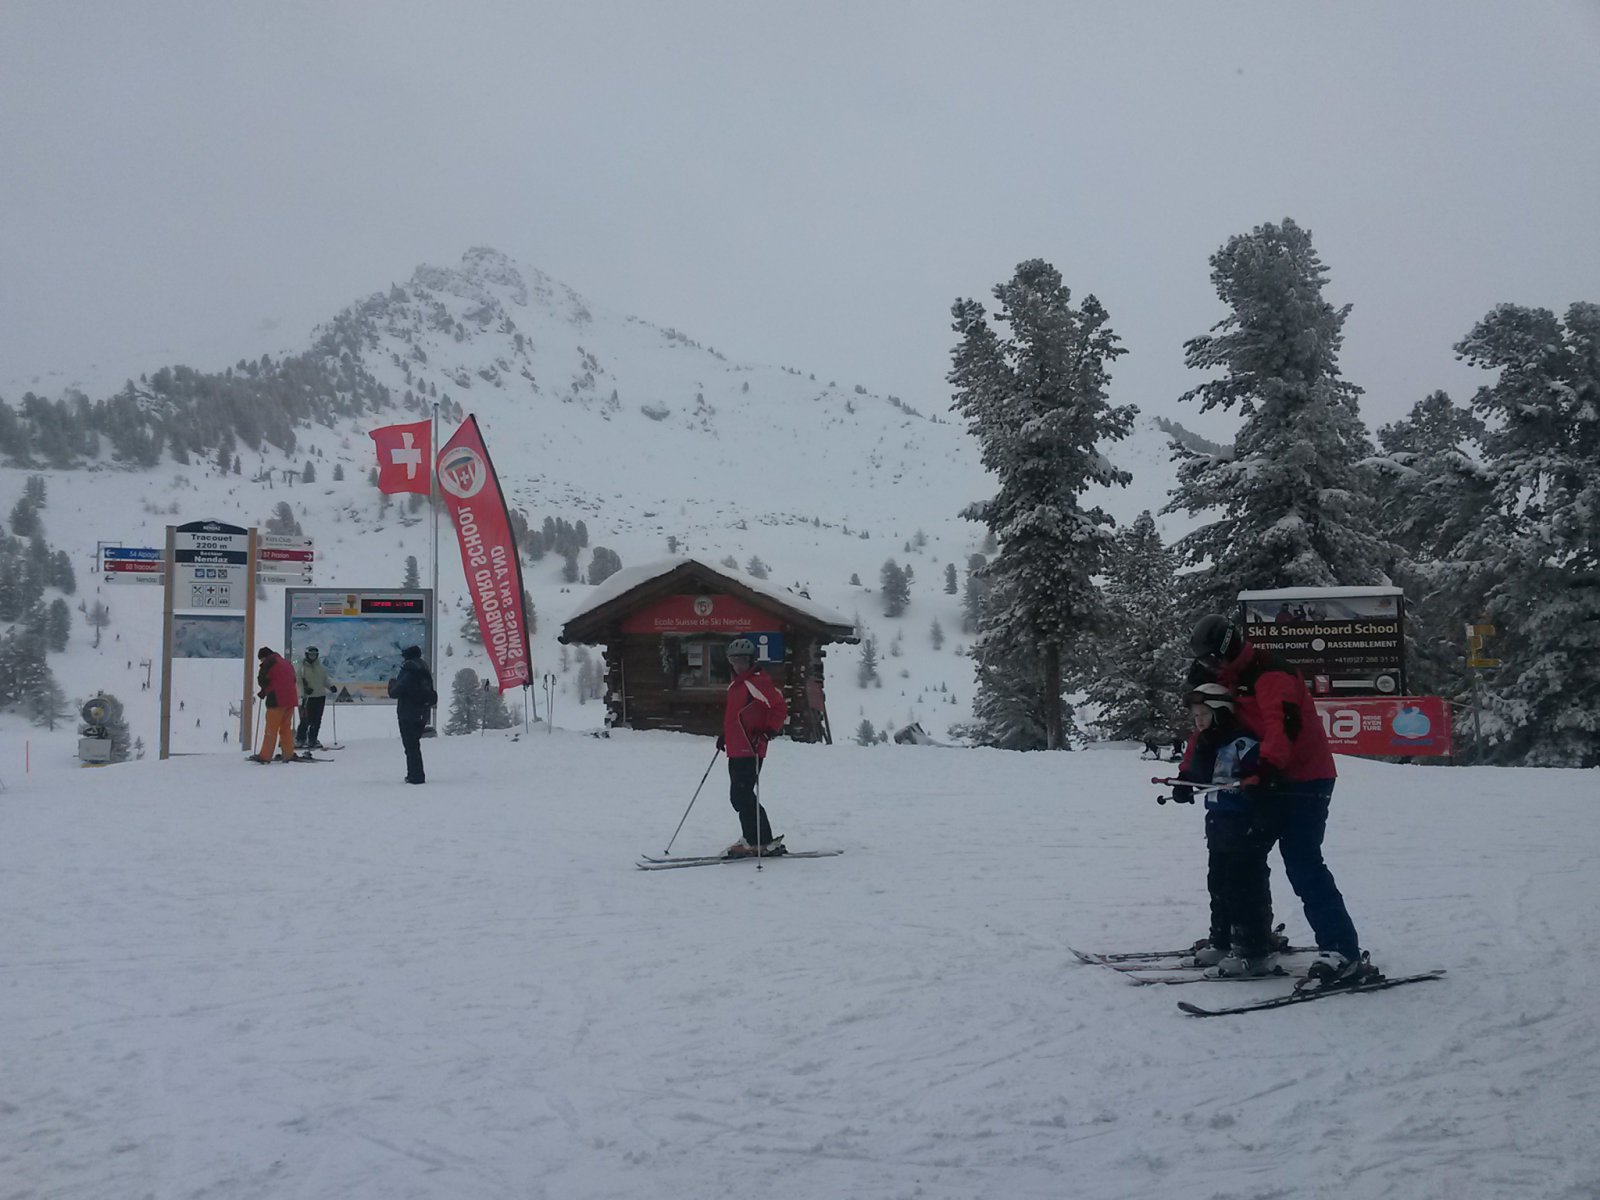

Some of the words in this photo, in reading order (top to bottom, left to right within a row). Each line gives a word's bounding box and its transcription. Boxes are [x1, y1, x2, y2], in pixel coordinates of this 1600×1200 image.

[191, 534, 233, 542] Tracouet
[654, 618, 674, 626] Ecole
[675, 618, 698, 626] Suisse
[699, 618, 709, 626] de
[711, 618, 721, 626] Ski
[723, 618, 752, 626] Nendaz
[1248, 626, 1267, 637] Ski
[1269, 626, 1279, 636] &
[1281, 624, 1352, 637] Snowboard
[1355, 623, 1398, 635] School
[1327, 640, 1398, 649] RASSEMBLEMENT
